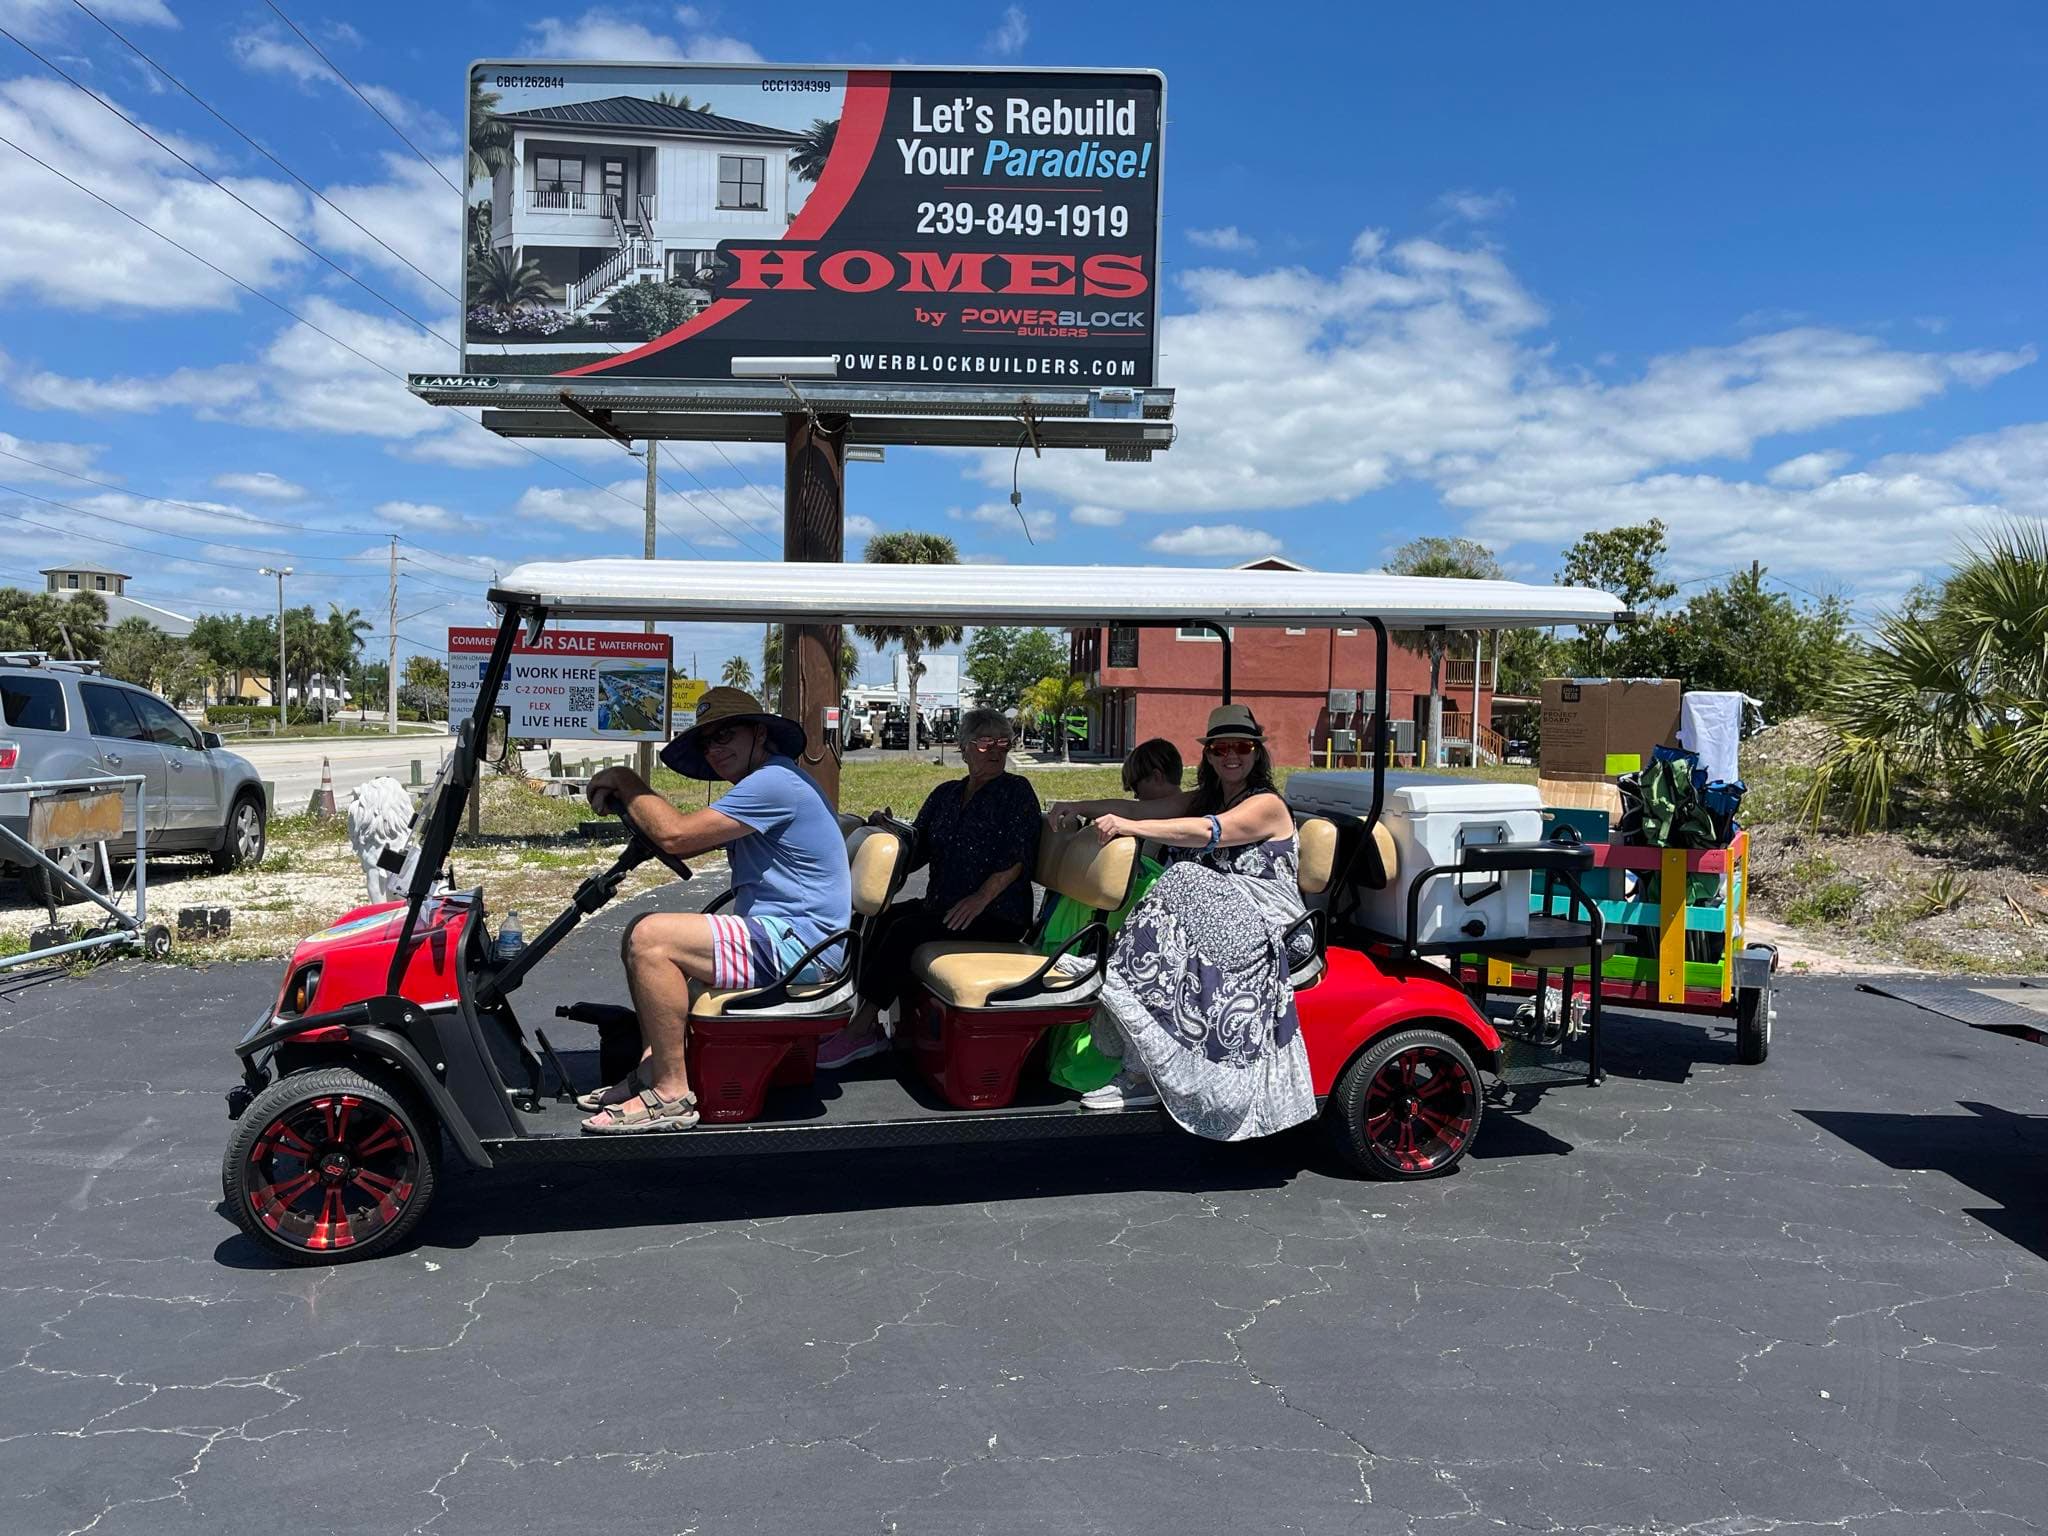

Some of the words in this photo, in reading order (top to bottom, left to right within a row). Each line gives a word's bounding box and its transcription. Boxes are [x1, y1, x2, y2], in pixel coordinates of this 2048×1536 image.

[496, 76, 564, 88] CBC1262844
[762, 80, 831, 92] CCC1334399
[912, 97, 994, 134] Let’s
[1006, 98, 1136, 136] Rebuild
[896, 138, 975, 175] Your
[982, 139, 1152, 178] Paradise!
[916, 202, 1129, 237] 239-849-1919
[726, 249, 1148, 298] HOMES
[914, 307, 948, 327] by
[961, 308, 1145, 327] POWERBLOCK
[1017, 328, 1089, 338] BUILDERS
[420, 377, 490, 387] LAMAR
[558, 637, 596, 651] SALE
[600, 641, 665, 651] WATERFRONT
[516, 666, 558, 679] WORK
[562, 668, 596, 680] HERE
[515, 685, 531, 694] C-2
[532, 686, 565, 695] ZONED
[529, 702, 551, 711] FLEX
[522, 715, 550, 727] LIVE
[554, 716, 588, 728] HERE
